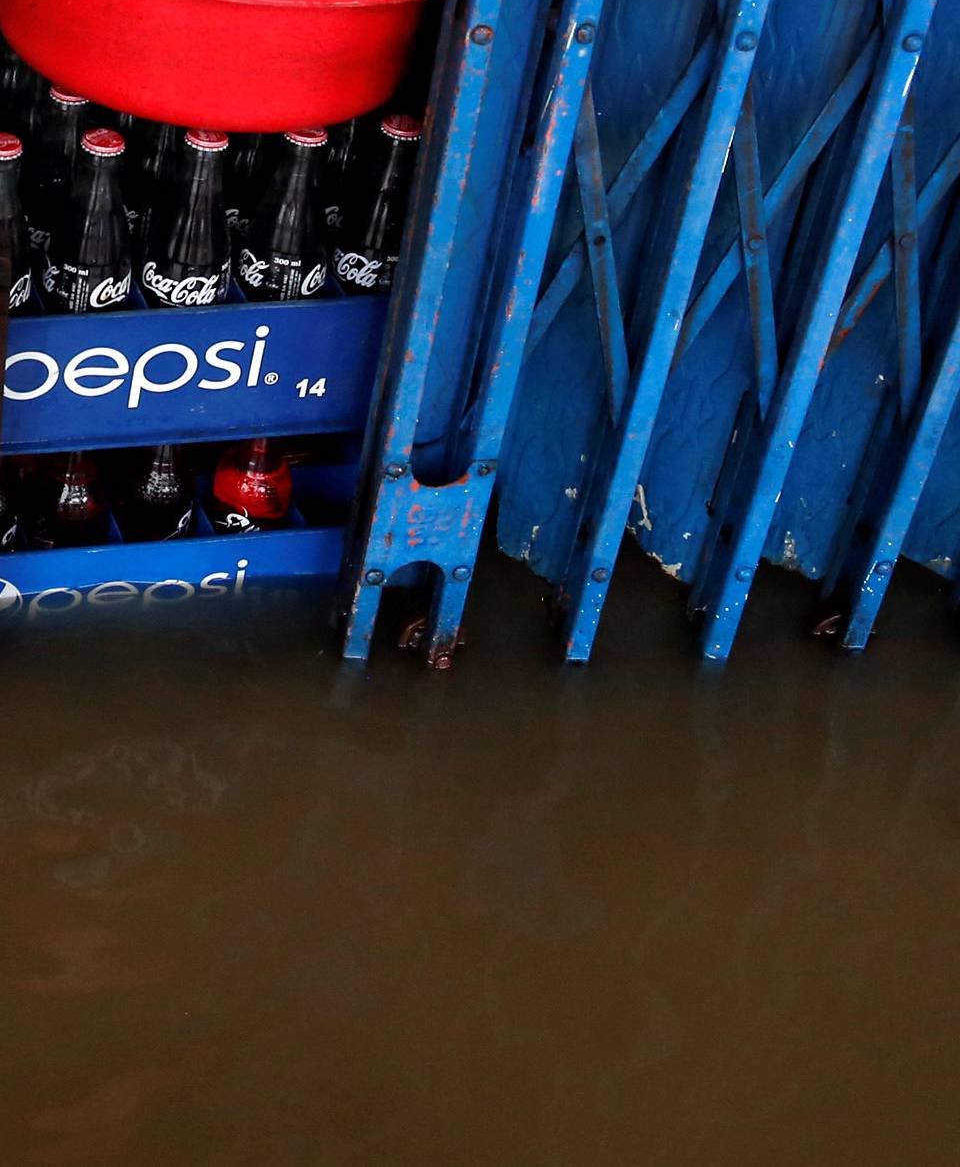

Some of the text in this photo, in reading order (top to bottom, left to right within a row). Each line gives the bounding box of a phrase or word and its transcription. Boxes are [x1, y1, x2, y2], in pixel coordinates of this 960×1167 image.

[273, 257, 290, 266] 300
[142, 261, 220, 307] Coca-Cola
[295, 377, 327, 398] 14
[28, 559, 249, 622] pepsi
